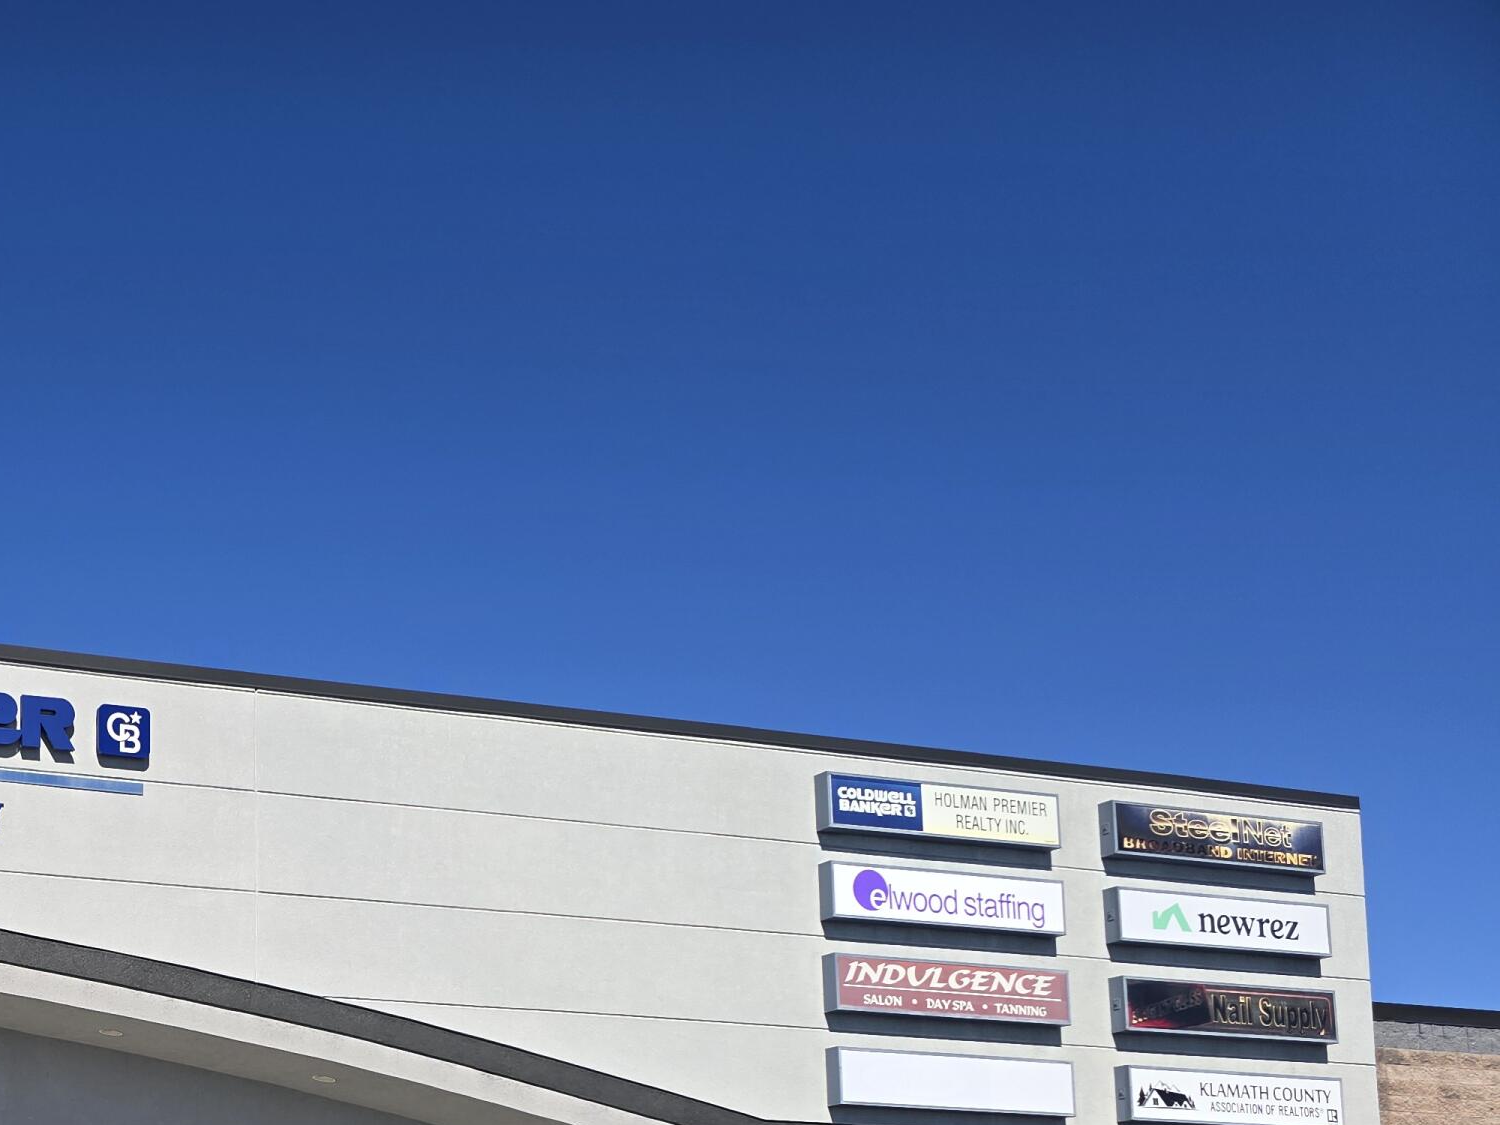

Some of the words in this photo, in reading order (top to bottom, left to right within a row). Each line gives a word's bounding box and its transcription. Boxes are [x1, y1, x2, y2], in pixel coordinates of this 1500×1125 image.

[837, 786, 916, 805] COLDWELL
[934, 792, 988, 811] HOLMAN
[993, 797, 1047, 817] PREMIER
[838, 801, 902, 817] BANKER
[956, 814, 1000, 833] REALTY
[1005, 820, 1029, 835] INC.
[869, 884, 958, 914] elwood
[963, 893, 1045, 929] staffing
[1197, 912, 1300, 941] newrez
[844, 961, 1056, 996] INDULGENCE
[863, 994, 903, 1007] SALON
[926, 998, 951, 1010] DAY
[952, 1000, 975, 1012] SPA
[994, 1003, 1048, 1018] TANNING
[1211, 993, 1253, 1026] Nail
[1258, 997, 1328, 1036] Supply
[1200, 1082, 1269, 1101] KLAMATH
[1273, 1087, 1332, 1104] COUNTY
[1210, 1101, 1263, 1115] ASSOCIATION
[1266, 1105, 1276, 1116] OF
